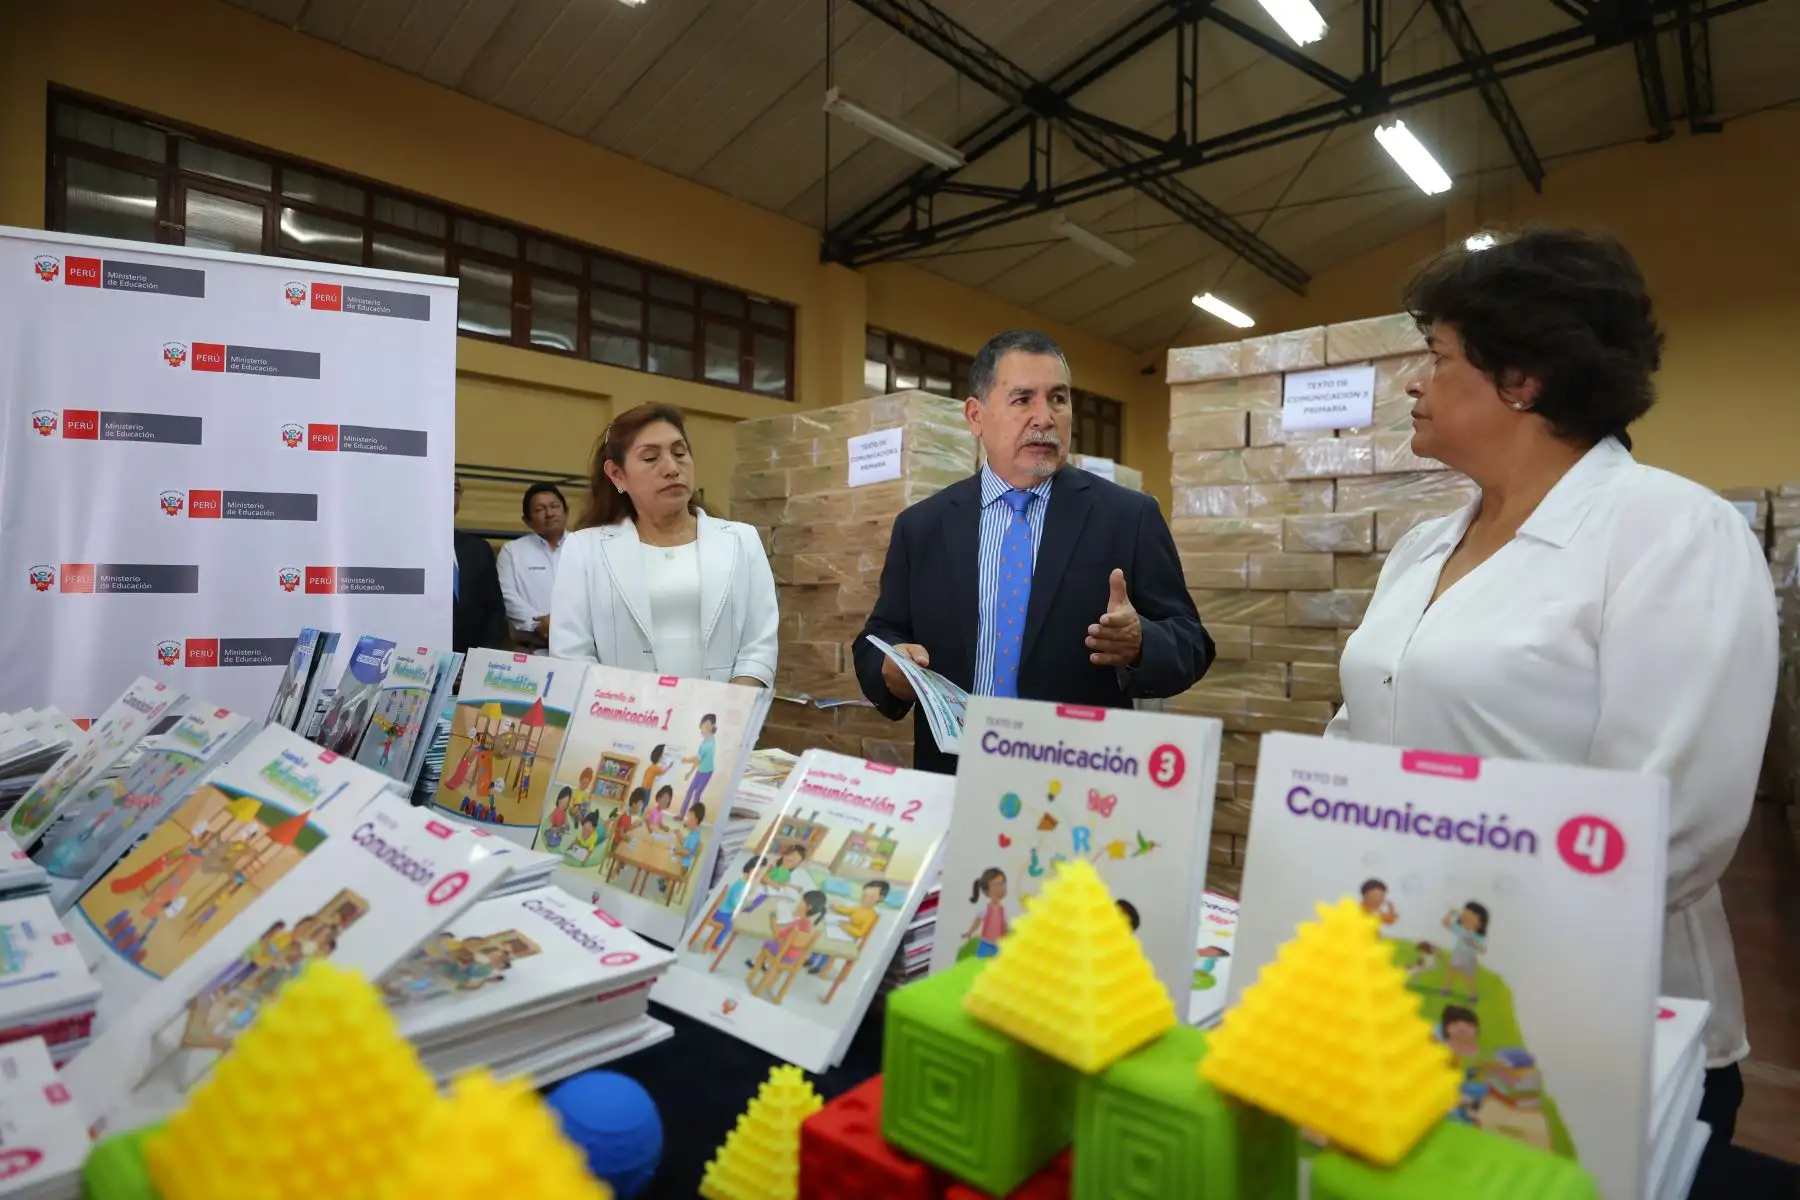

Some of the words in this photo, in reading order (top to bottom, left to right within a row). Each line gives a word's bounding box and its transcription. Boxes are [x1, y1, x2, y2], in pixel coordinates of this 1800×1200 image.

[70, 268, 96, 278] PERÚ
[107, 271, 147, 282] Ministerio
[119, 279, 159, 289] Educación
[315, 292, 337, 302] PERÚ
[347, 296, 381, 306] Ministerio
[357, 303, 391, 313] Educación
[196, 353, 220, 363] PERÚ
[230, 356, 268, 365] Ministerio
[241, 363, 278, 373] Educación
[1307, 380, 1334, 390] TEXTO
[1336, 379, 1348, 387] DE
[1303, 405, 1347, 415] PRIMARIA
[68, 420, 94, 430] PERÚ
[105, 422, 144, 431] Ministerio
[116, 430, 155, 438] Educación
[312, 434, 334, 443] PERÚ
[343, 435, 378, 444] Ministerio
[353, 442, 388, 451] Educación
[861, 441, 878, 450] TEXTO
[193, 500, 217, 509] PERÚ
[227, 501, 265, 510] Ministerio
[238, 508, 275, 517] Educación
[309, 576, 332, 585] PERÚ
[190, 648, 213, 658] PERÚ
[235, 655, 272, 663] Educación
[543, 672, 554, 698] 1
[627, 694, 635, 703] de
[590, 701, 659, 728] Comunicación
[661, 708, 673, 731] 1
[986, 716, 1011, 728] TEXTO
[981, 730, 1138, 776] Comunicación
[1156, 751, 1176, 782] 3
[1291, 769, 1330, 785] TEXTO
[1332, 774, 1349, 787] DE
[900, 799, 923, 822] 2
[1286, 785, 1537, 855] Comunicación
[1573, 824, 1607, 867] 4
[351, 822, 435, 887] Comunicación
